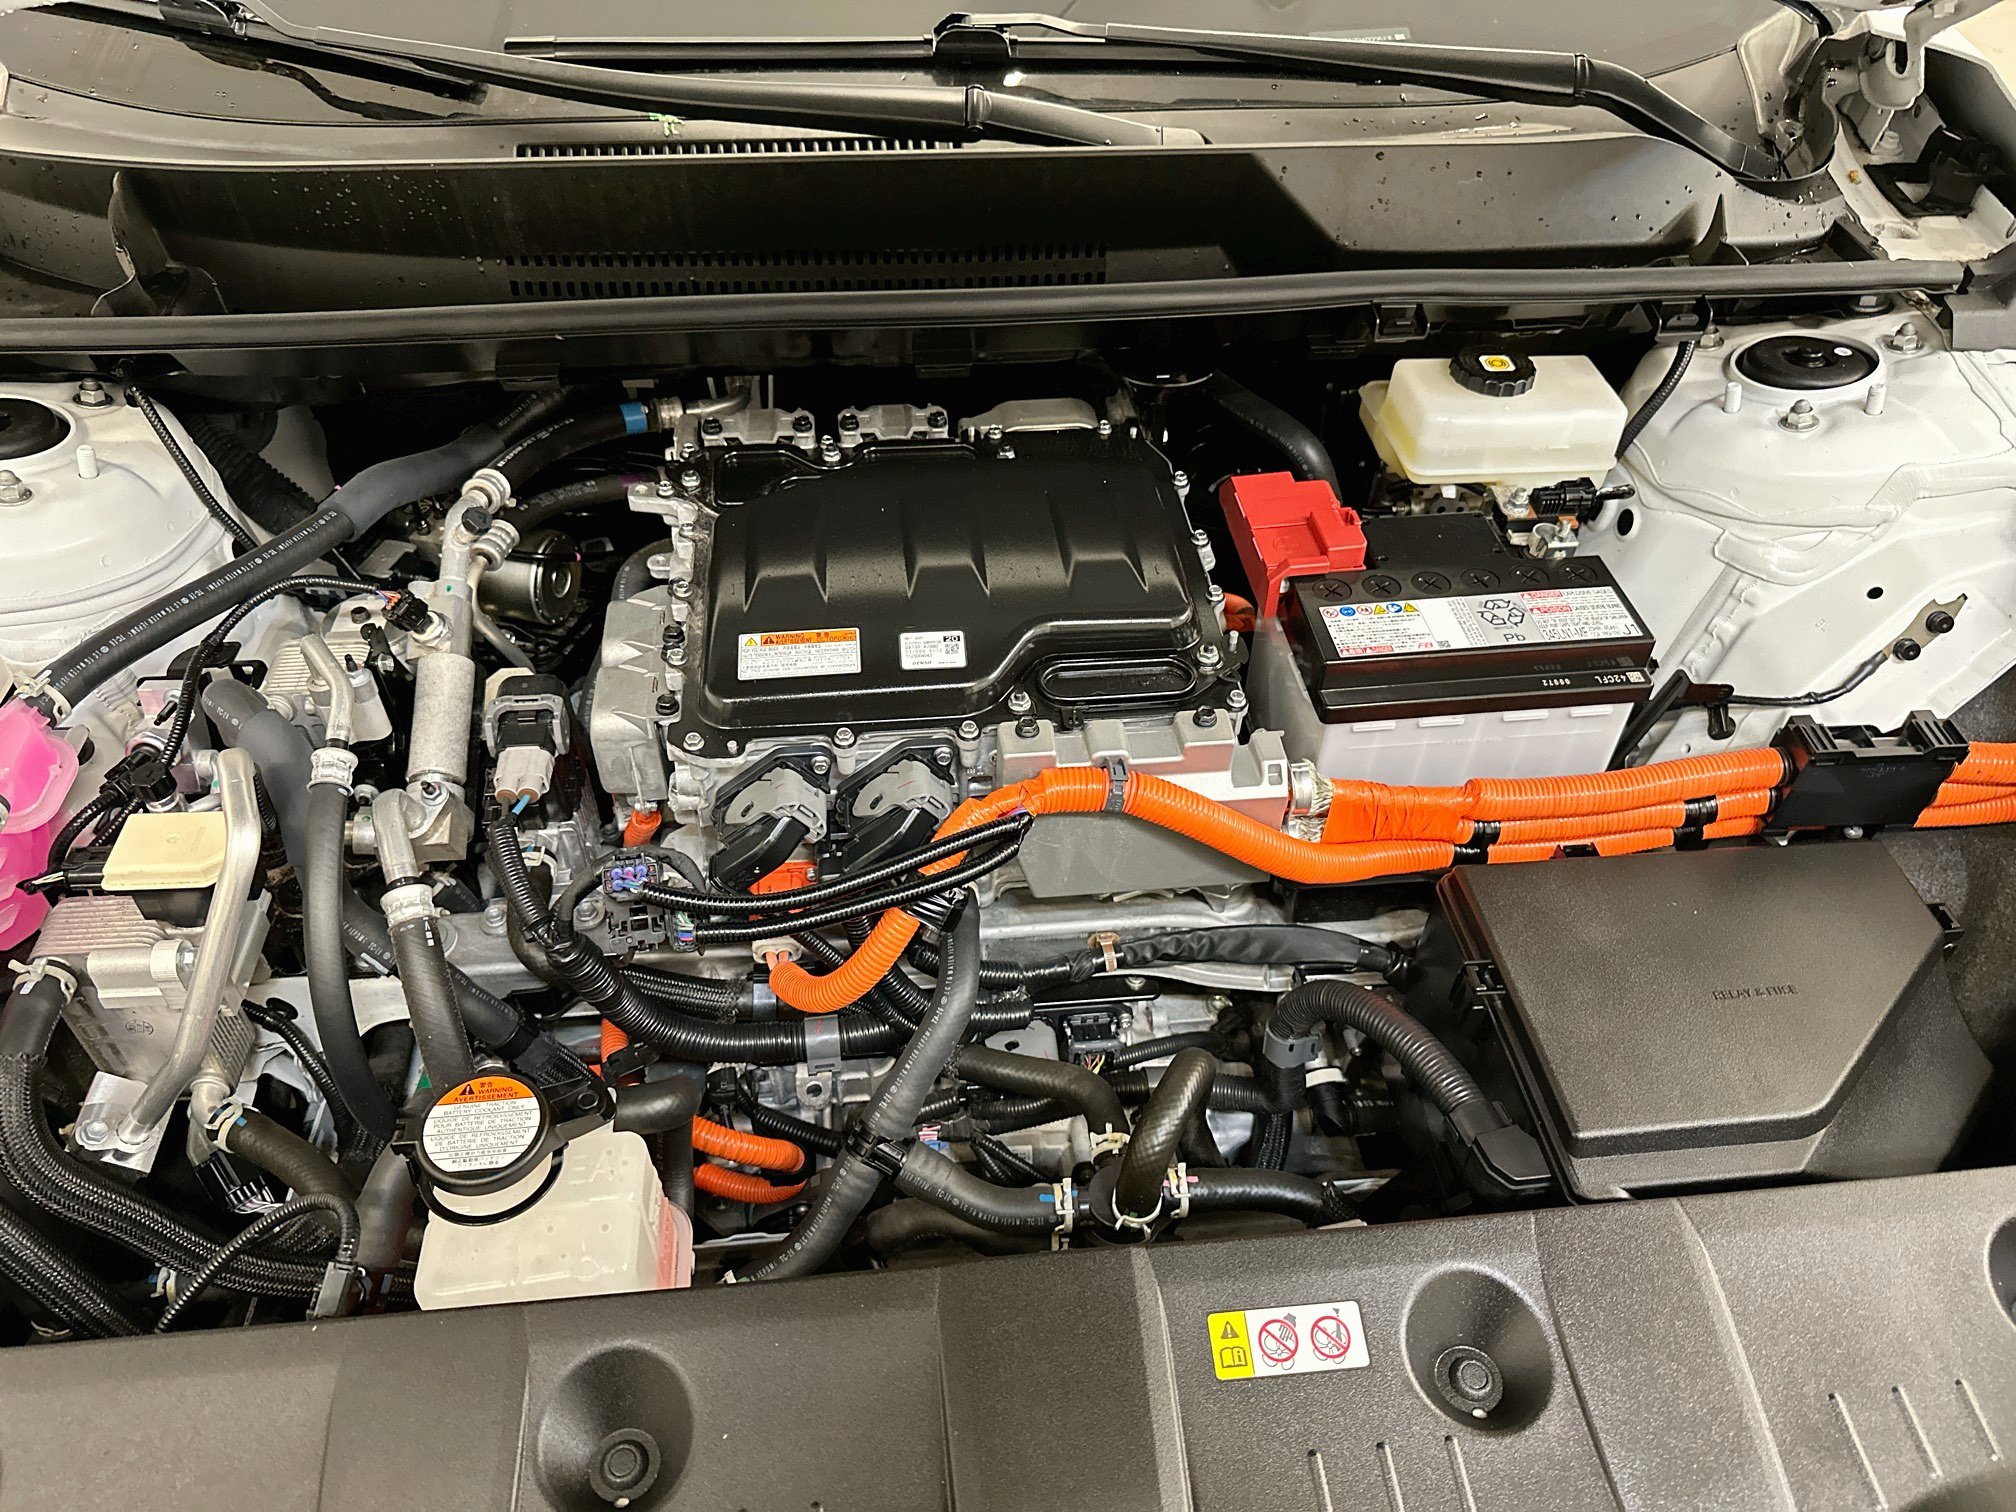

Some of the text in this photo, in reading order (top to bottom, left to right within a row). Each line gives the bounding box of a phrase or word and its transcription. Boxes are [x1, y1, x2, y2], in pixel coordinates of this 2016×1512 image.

[1503, 633, 1526, 642] Pb
[1712, 985, 1798, 1000] RELAY & FUSE
[478, 1086, 513, 1095] WARNING
[454, 1092, 519, 1102] AVERTISSEMENT
[977, 1212, 999, 1224] WATER
